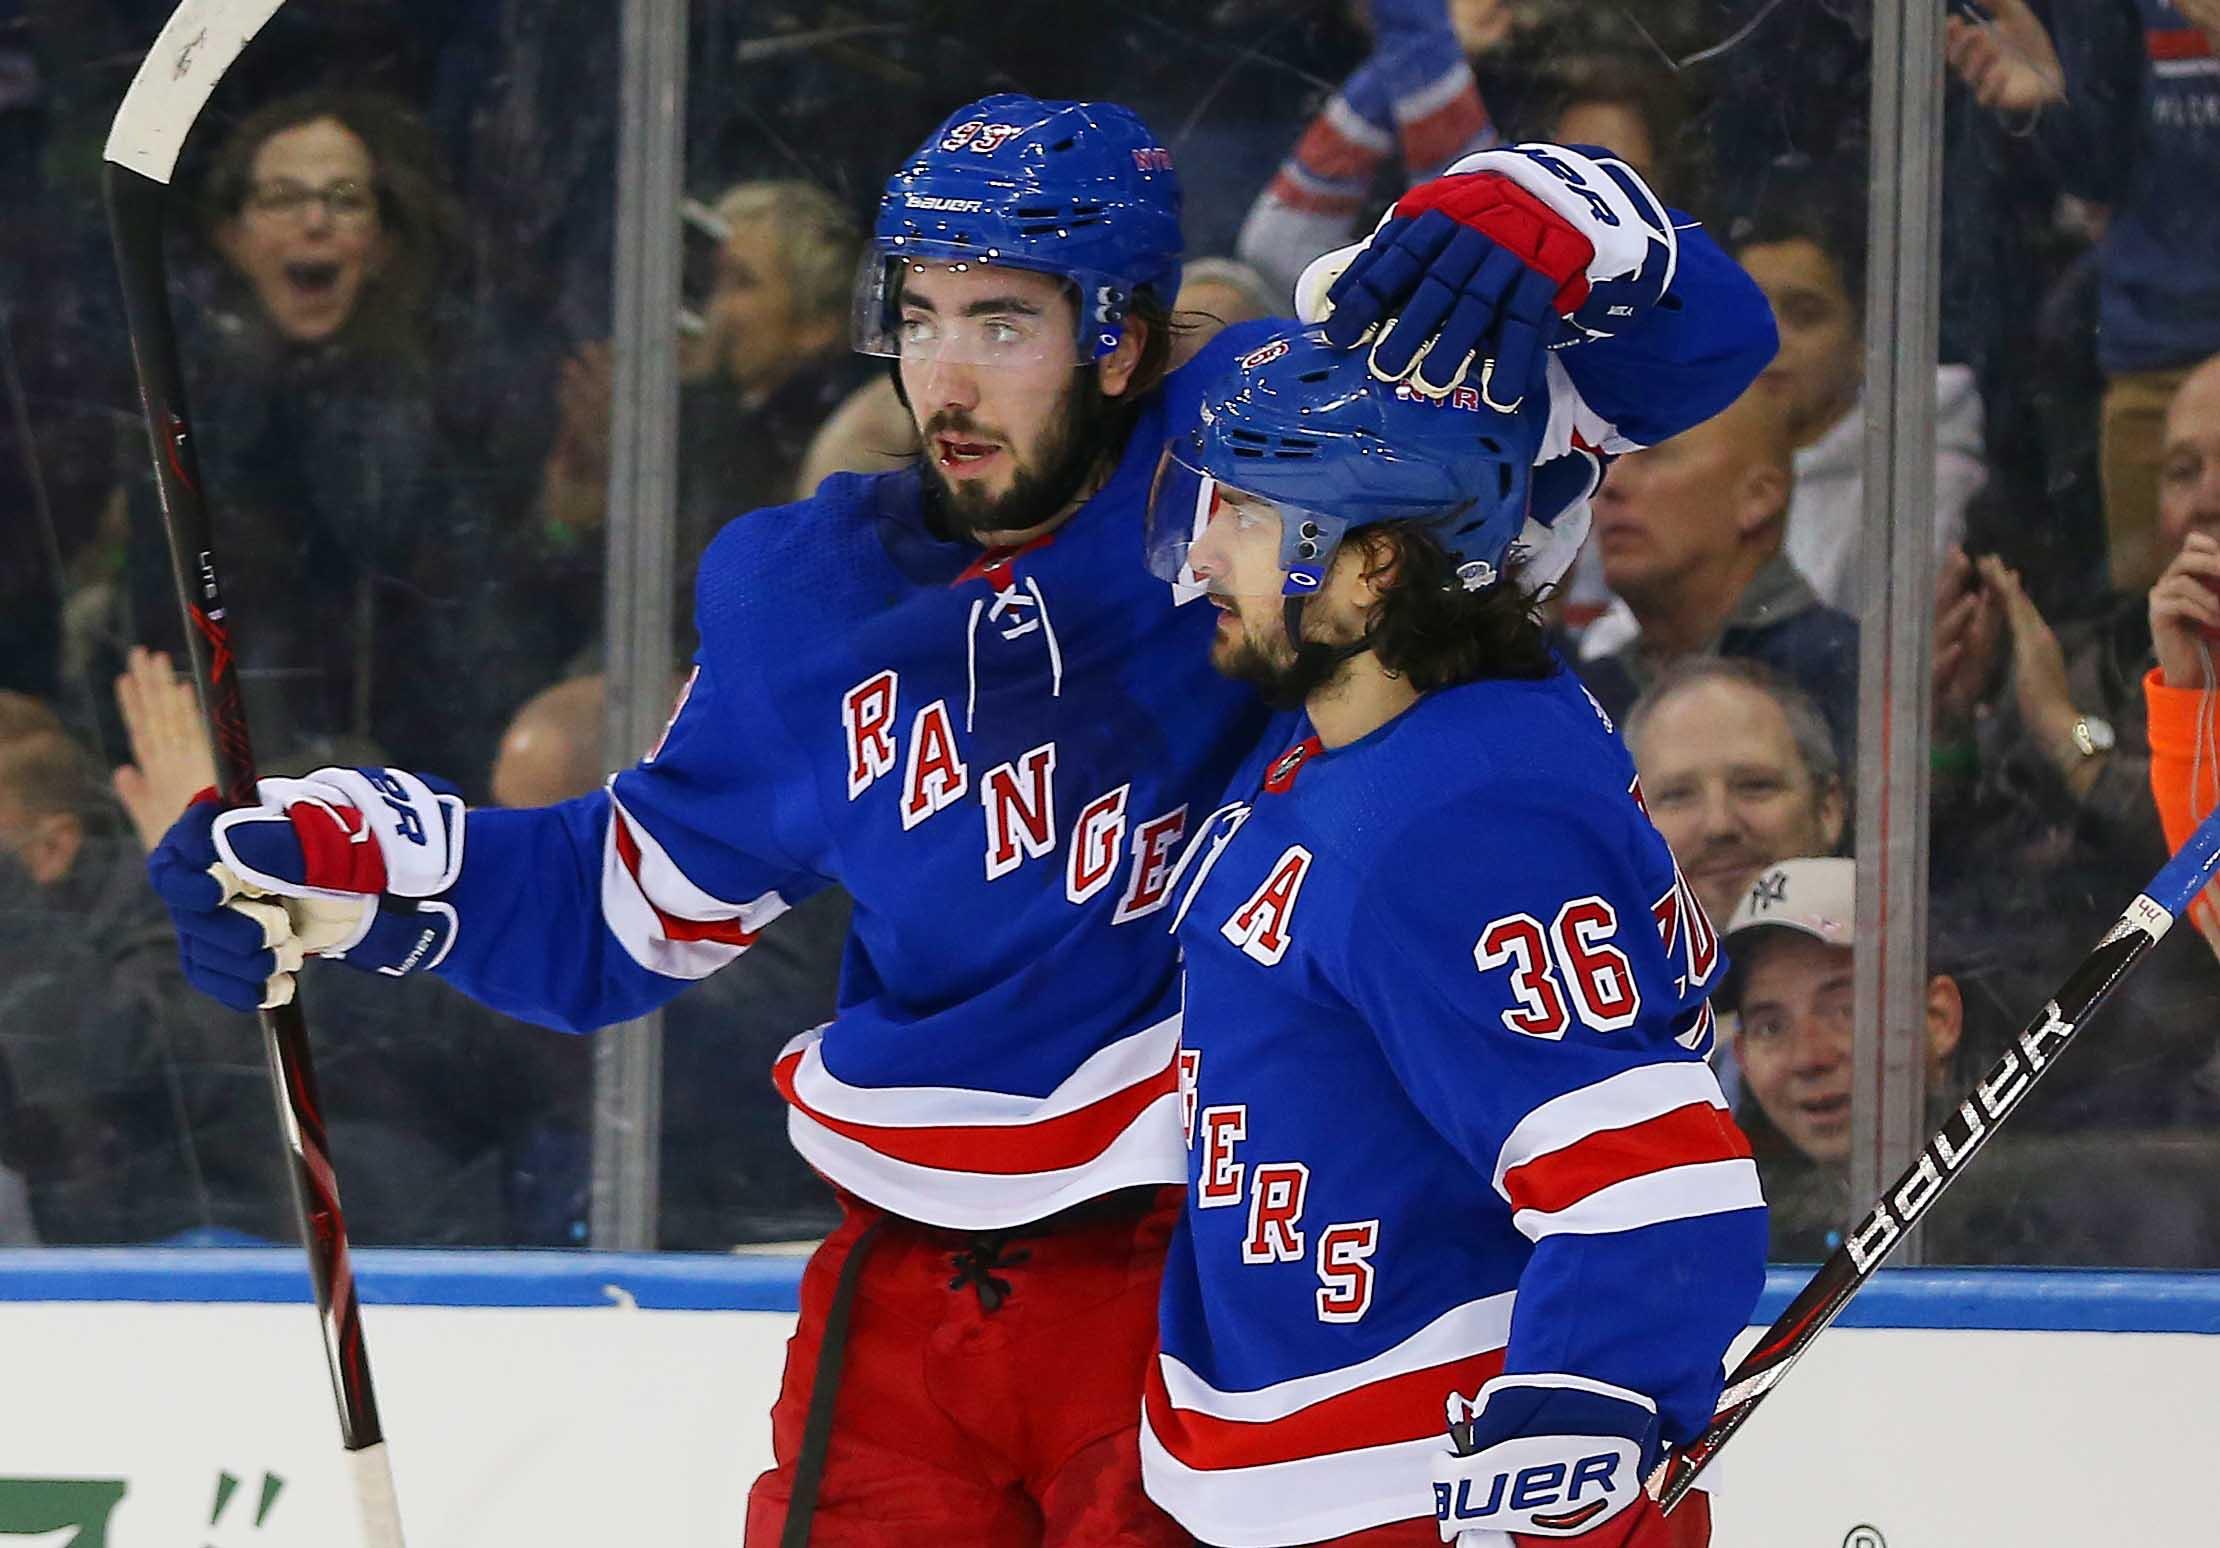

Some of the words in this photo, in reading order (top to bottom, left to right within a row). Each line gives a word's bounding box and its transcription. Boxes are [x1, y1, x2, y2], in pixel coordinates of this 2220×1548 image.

[905, 195, 982, 212] BAUER
[1220, 844, 1313, 967] A
[1473, 895, 1641, 1041] 36
[1845, 999, 2075, 1256] BAUER
